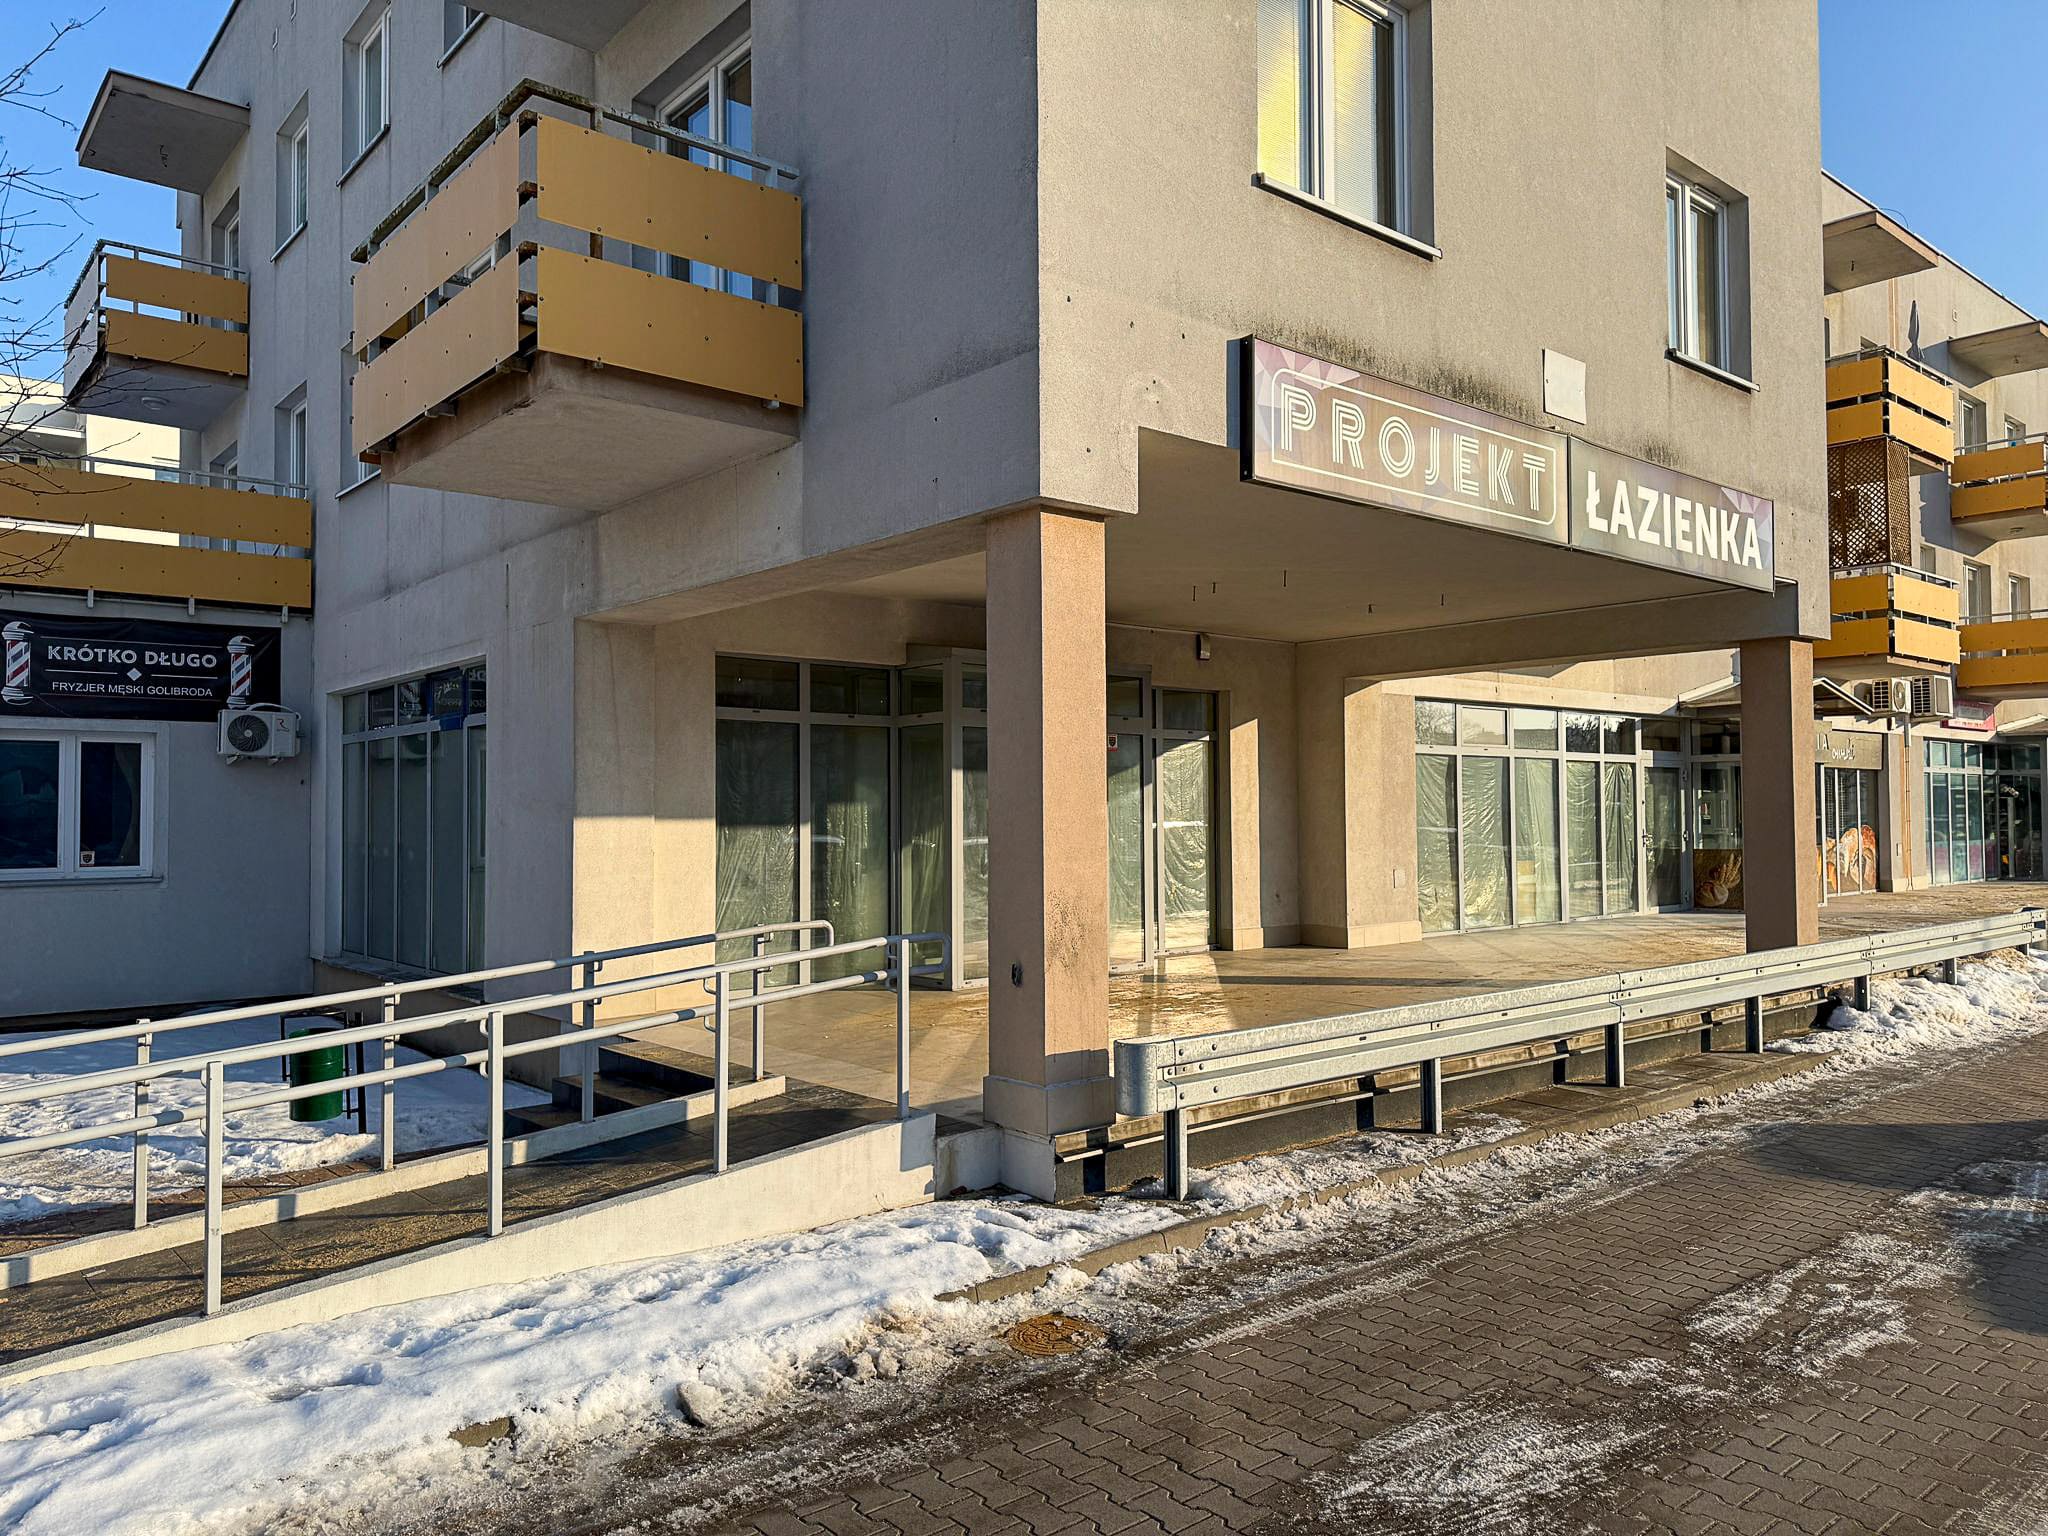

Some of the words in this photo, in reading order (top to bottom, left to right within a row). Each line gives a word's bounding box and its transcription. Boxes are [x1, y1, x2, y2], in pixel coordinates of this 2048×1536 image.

[1279, 382, 1546, 511] PROJEKT
[1585, 470, 1763, 570] ŁAZIENKA
[47, 644, 137, 664] KRÓTKO
[145, 651, 217, 668] DŁUGO
[52, 682, 105, 693] FRYZJER
[108, 685, 143, 696] MĘSKI
[147, 686, 213, 697] GOLIBRODA
